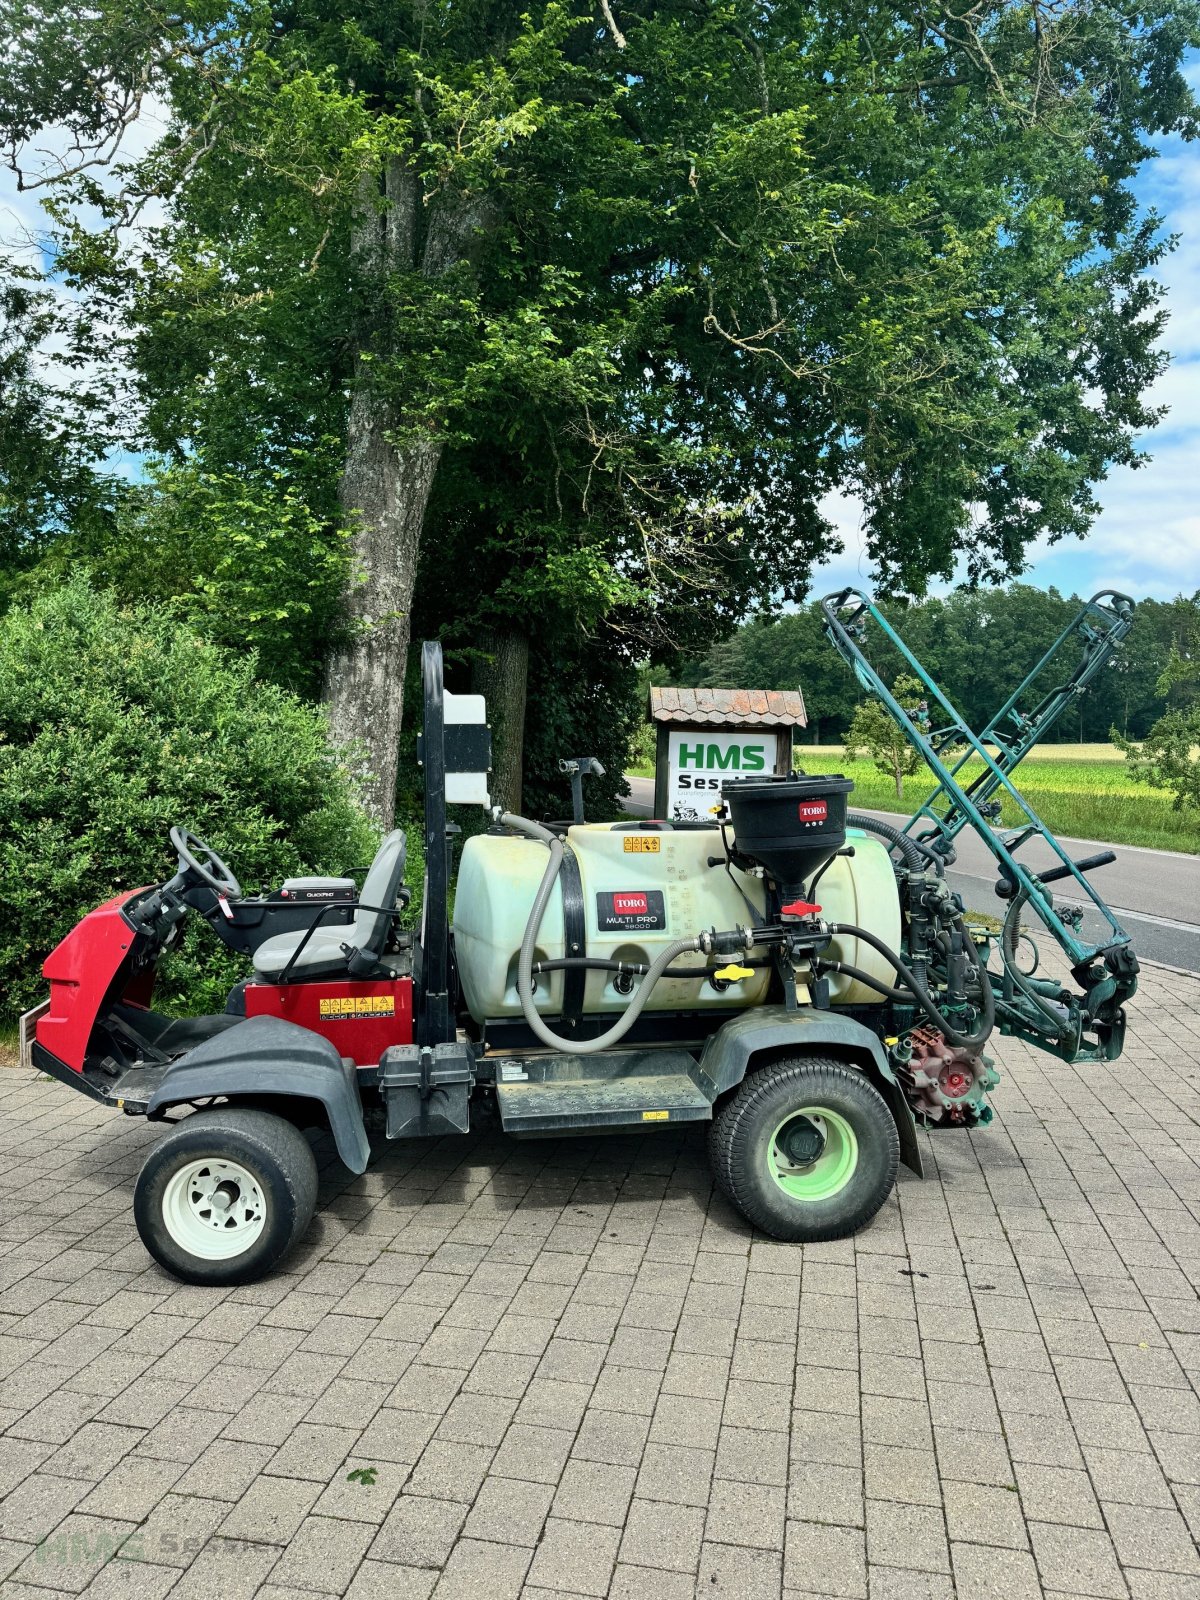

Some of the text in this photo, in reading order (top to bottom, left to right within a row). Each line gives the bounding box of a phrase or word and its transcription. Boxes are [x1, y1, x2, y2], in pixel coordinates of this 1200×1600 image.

[678, 743, 765, 770] HMS
[802, 807, 826, 816] TORO
[616, 899, 646, 908] TORO
[606, 916, 633, 924] MULTI
